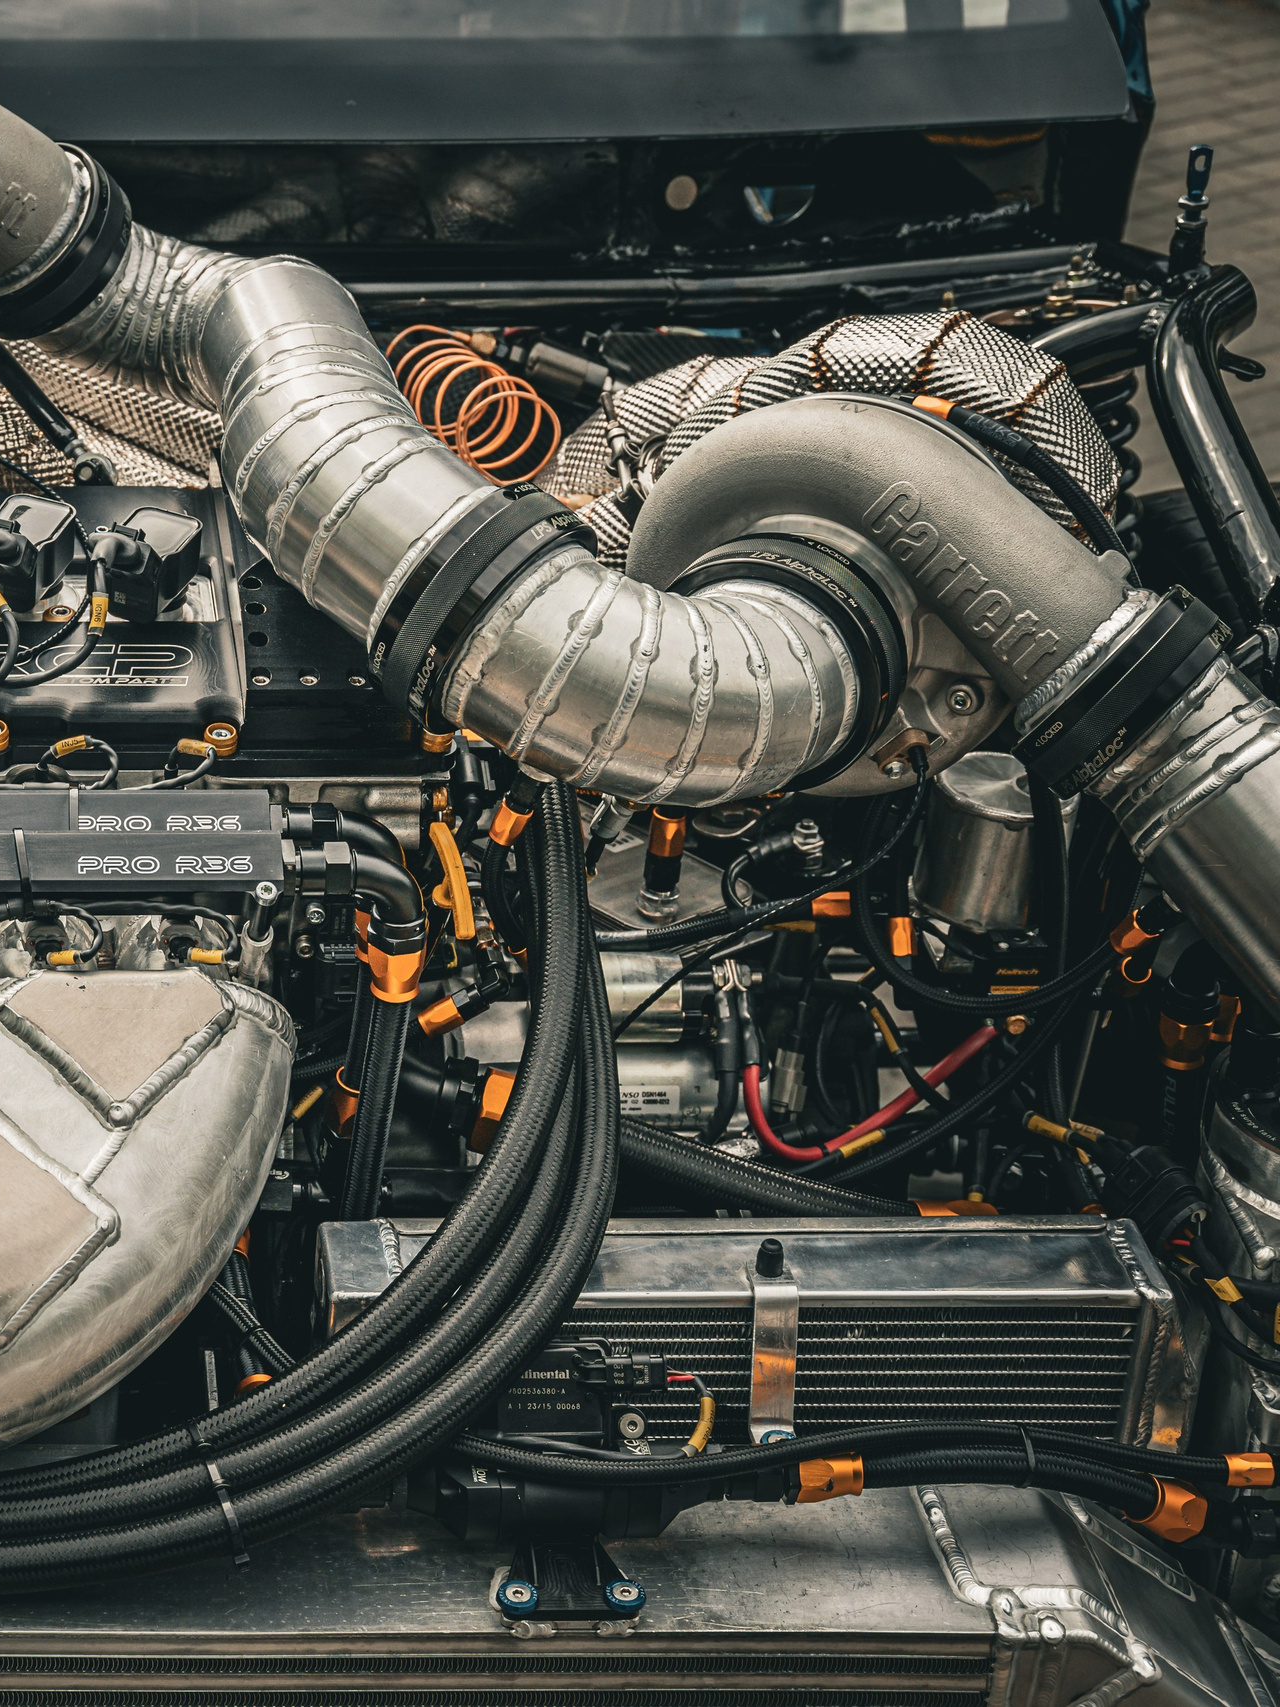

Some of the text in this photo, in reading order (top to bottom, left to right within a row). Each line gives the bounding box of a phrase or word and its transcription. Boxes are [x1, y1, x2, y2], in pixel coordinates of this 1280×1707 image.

[530, 521, 553, 541] LPS
[750, 551, 780, 561] LPS
[816, 543, 851, 566] LOCKED
[862, 481, 1060, 683] Garrett
[93, 603, 103, 624] IGN6
[372, 641, 386, 669] LOCKED
[114, 676, 184, 685] PARTS
[61, 738, 79, 748] INJ5
[1038, 721, 1064, 746] LOCKED
[78, 815, 242, 832] PRO R36
[77, 855, 253, 875] PRO R36
[1240, 1113, 1259, 1129] surge
[1258, 1129, 1277, 1141] tank
[521, 1369, 570, 1379] tinental
